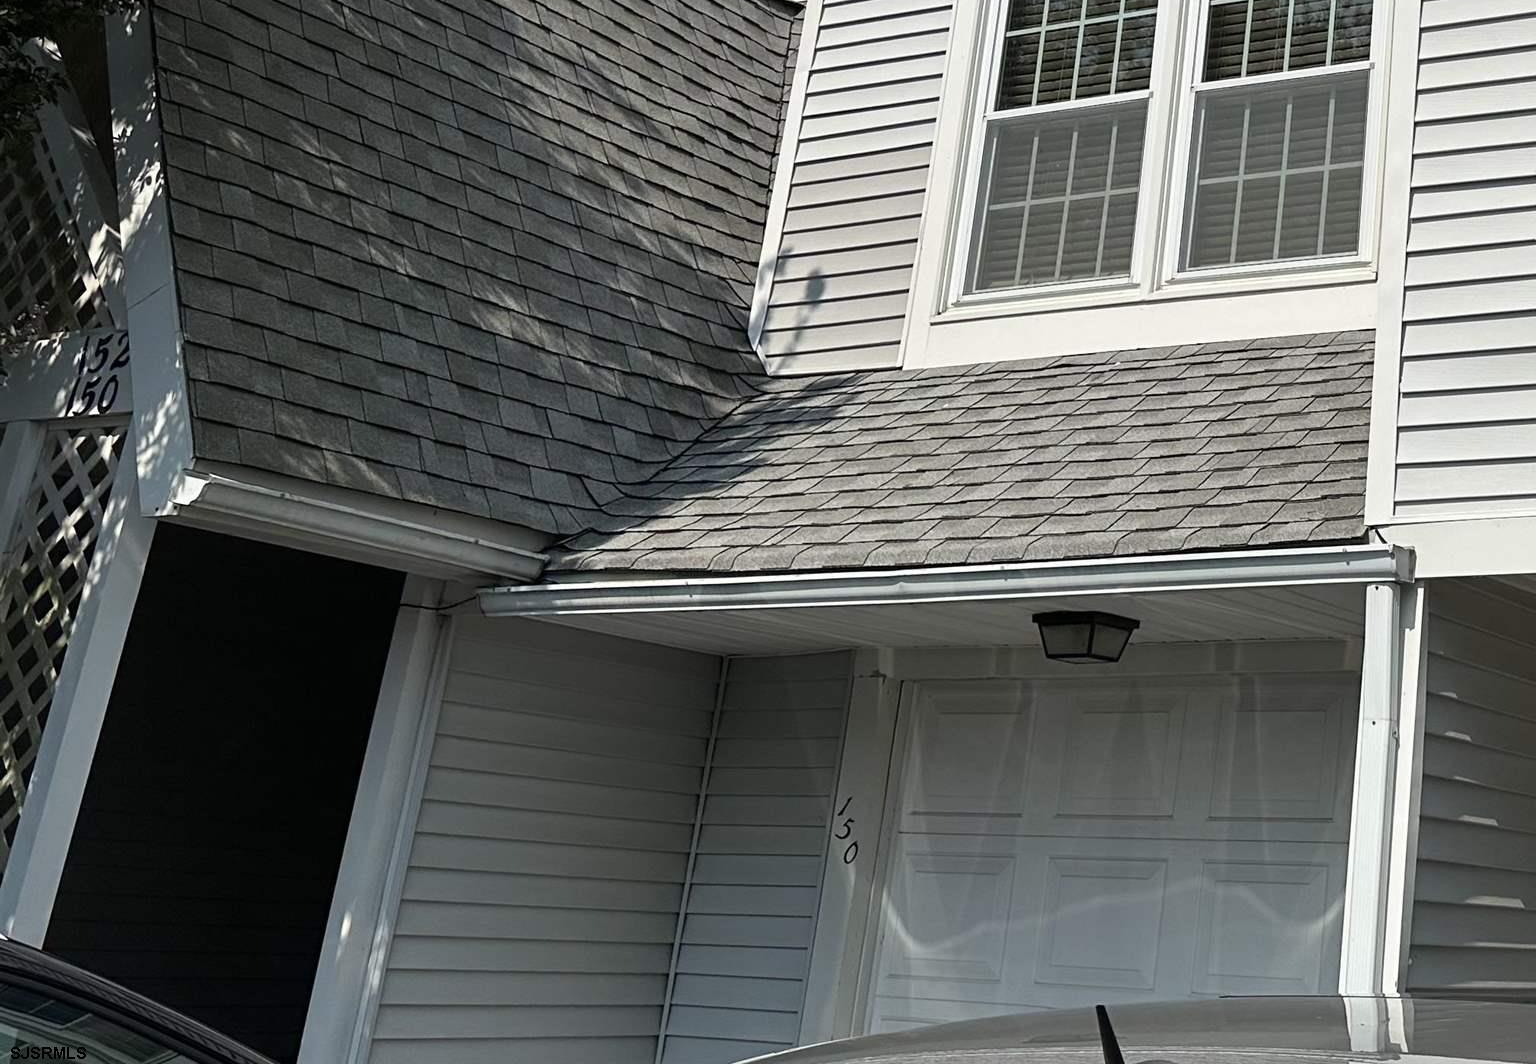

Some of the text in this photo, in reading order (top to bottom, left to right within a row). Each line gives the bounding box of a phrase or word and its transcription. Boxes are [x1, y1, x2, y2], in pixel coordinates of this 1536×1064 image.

[78, 331, 130, 376] 152
[65, 374, 119, 417] 150
[834, 796, 859, 865] 150
